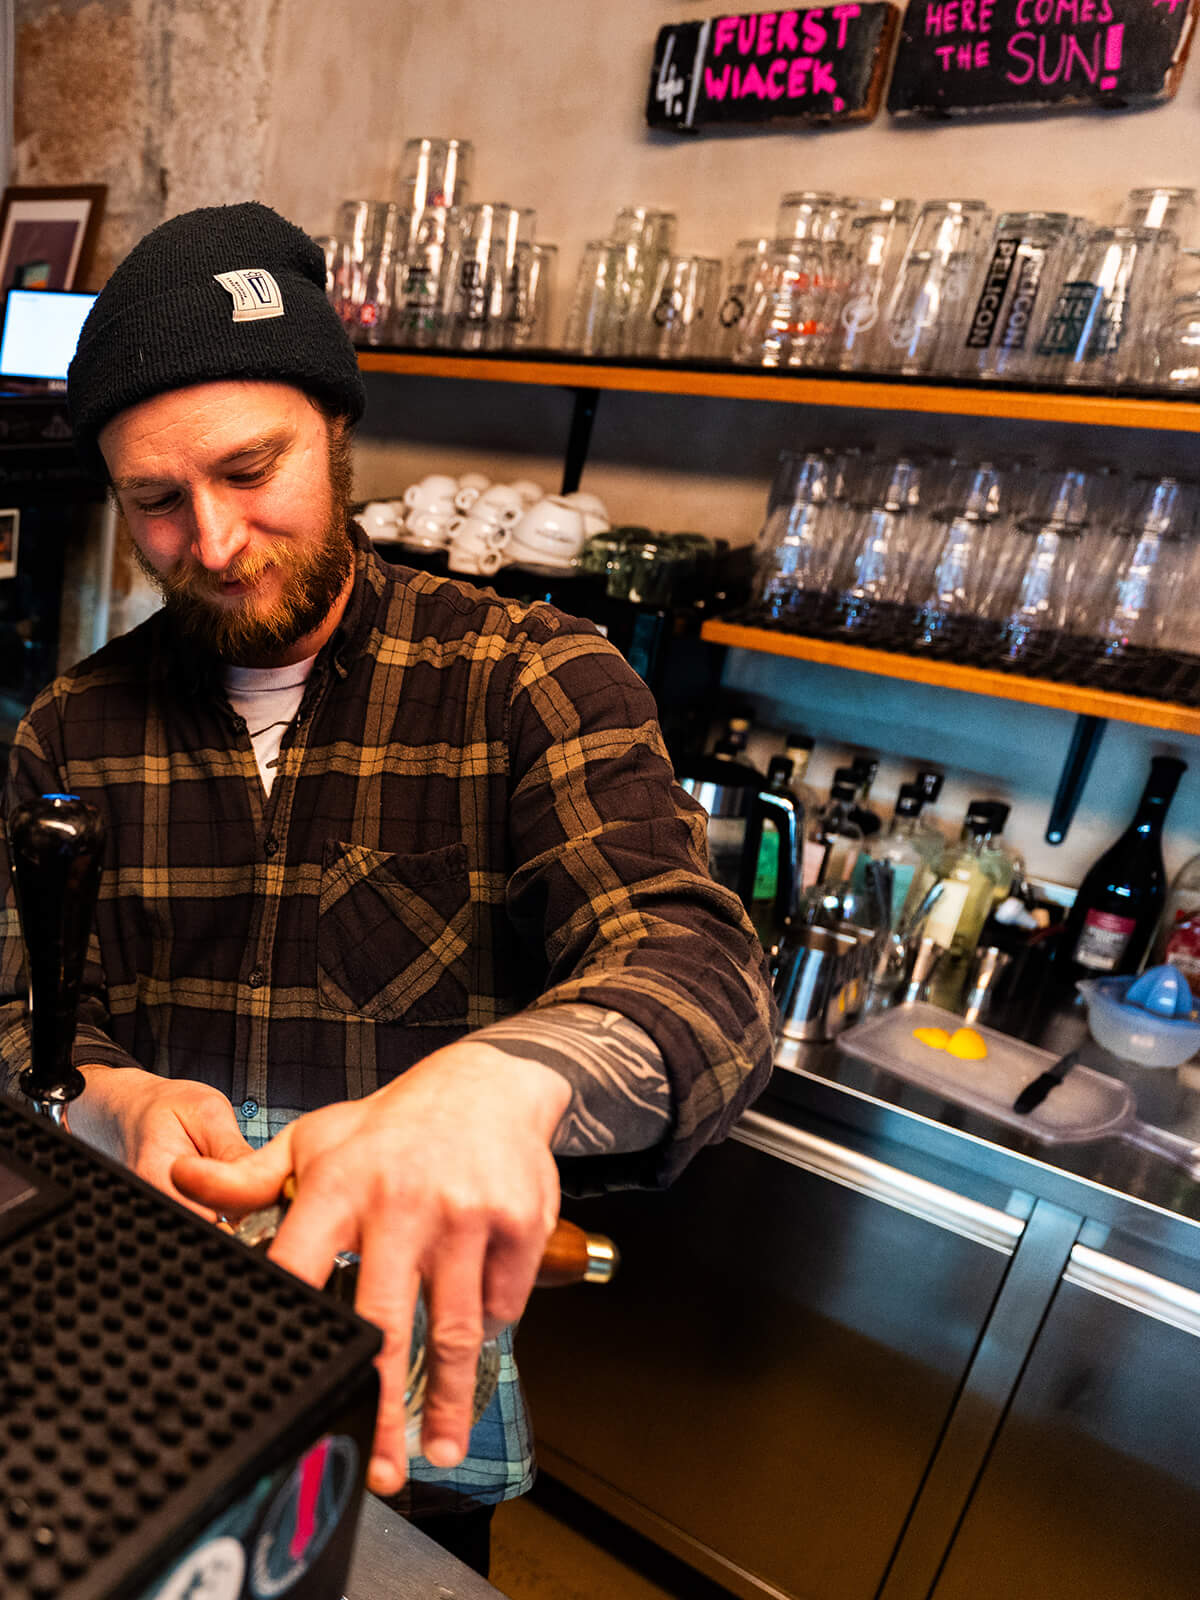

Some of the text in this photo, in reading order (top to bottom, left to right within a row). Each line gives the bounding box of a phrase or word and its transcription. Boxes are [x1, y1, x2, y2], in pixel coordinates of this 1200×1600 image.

[713, 4, 862, 56] FUERST
[925, 0, 1113, 36] HERE COMES
[935, 41, 990, 71] THE
[968, 240, 1017, 347] PELICON
